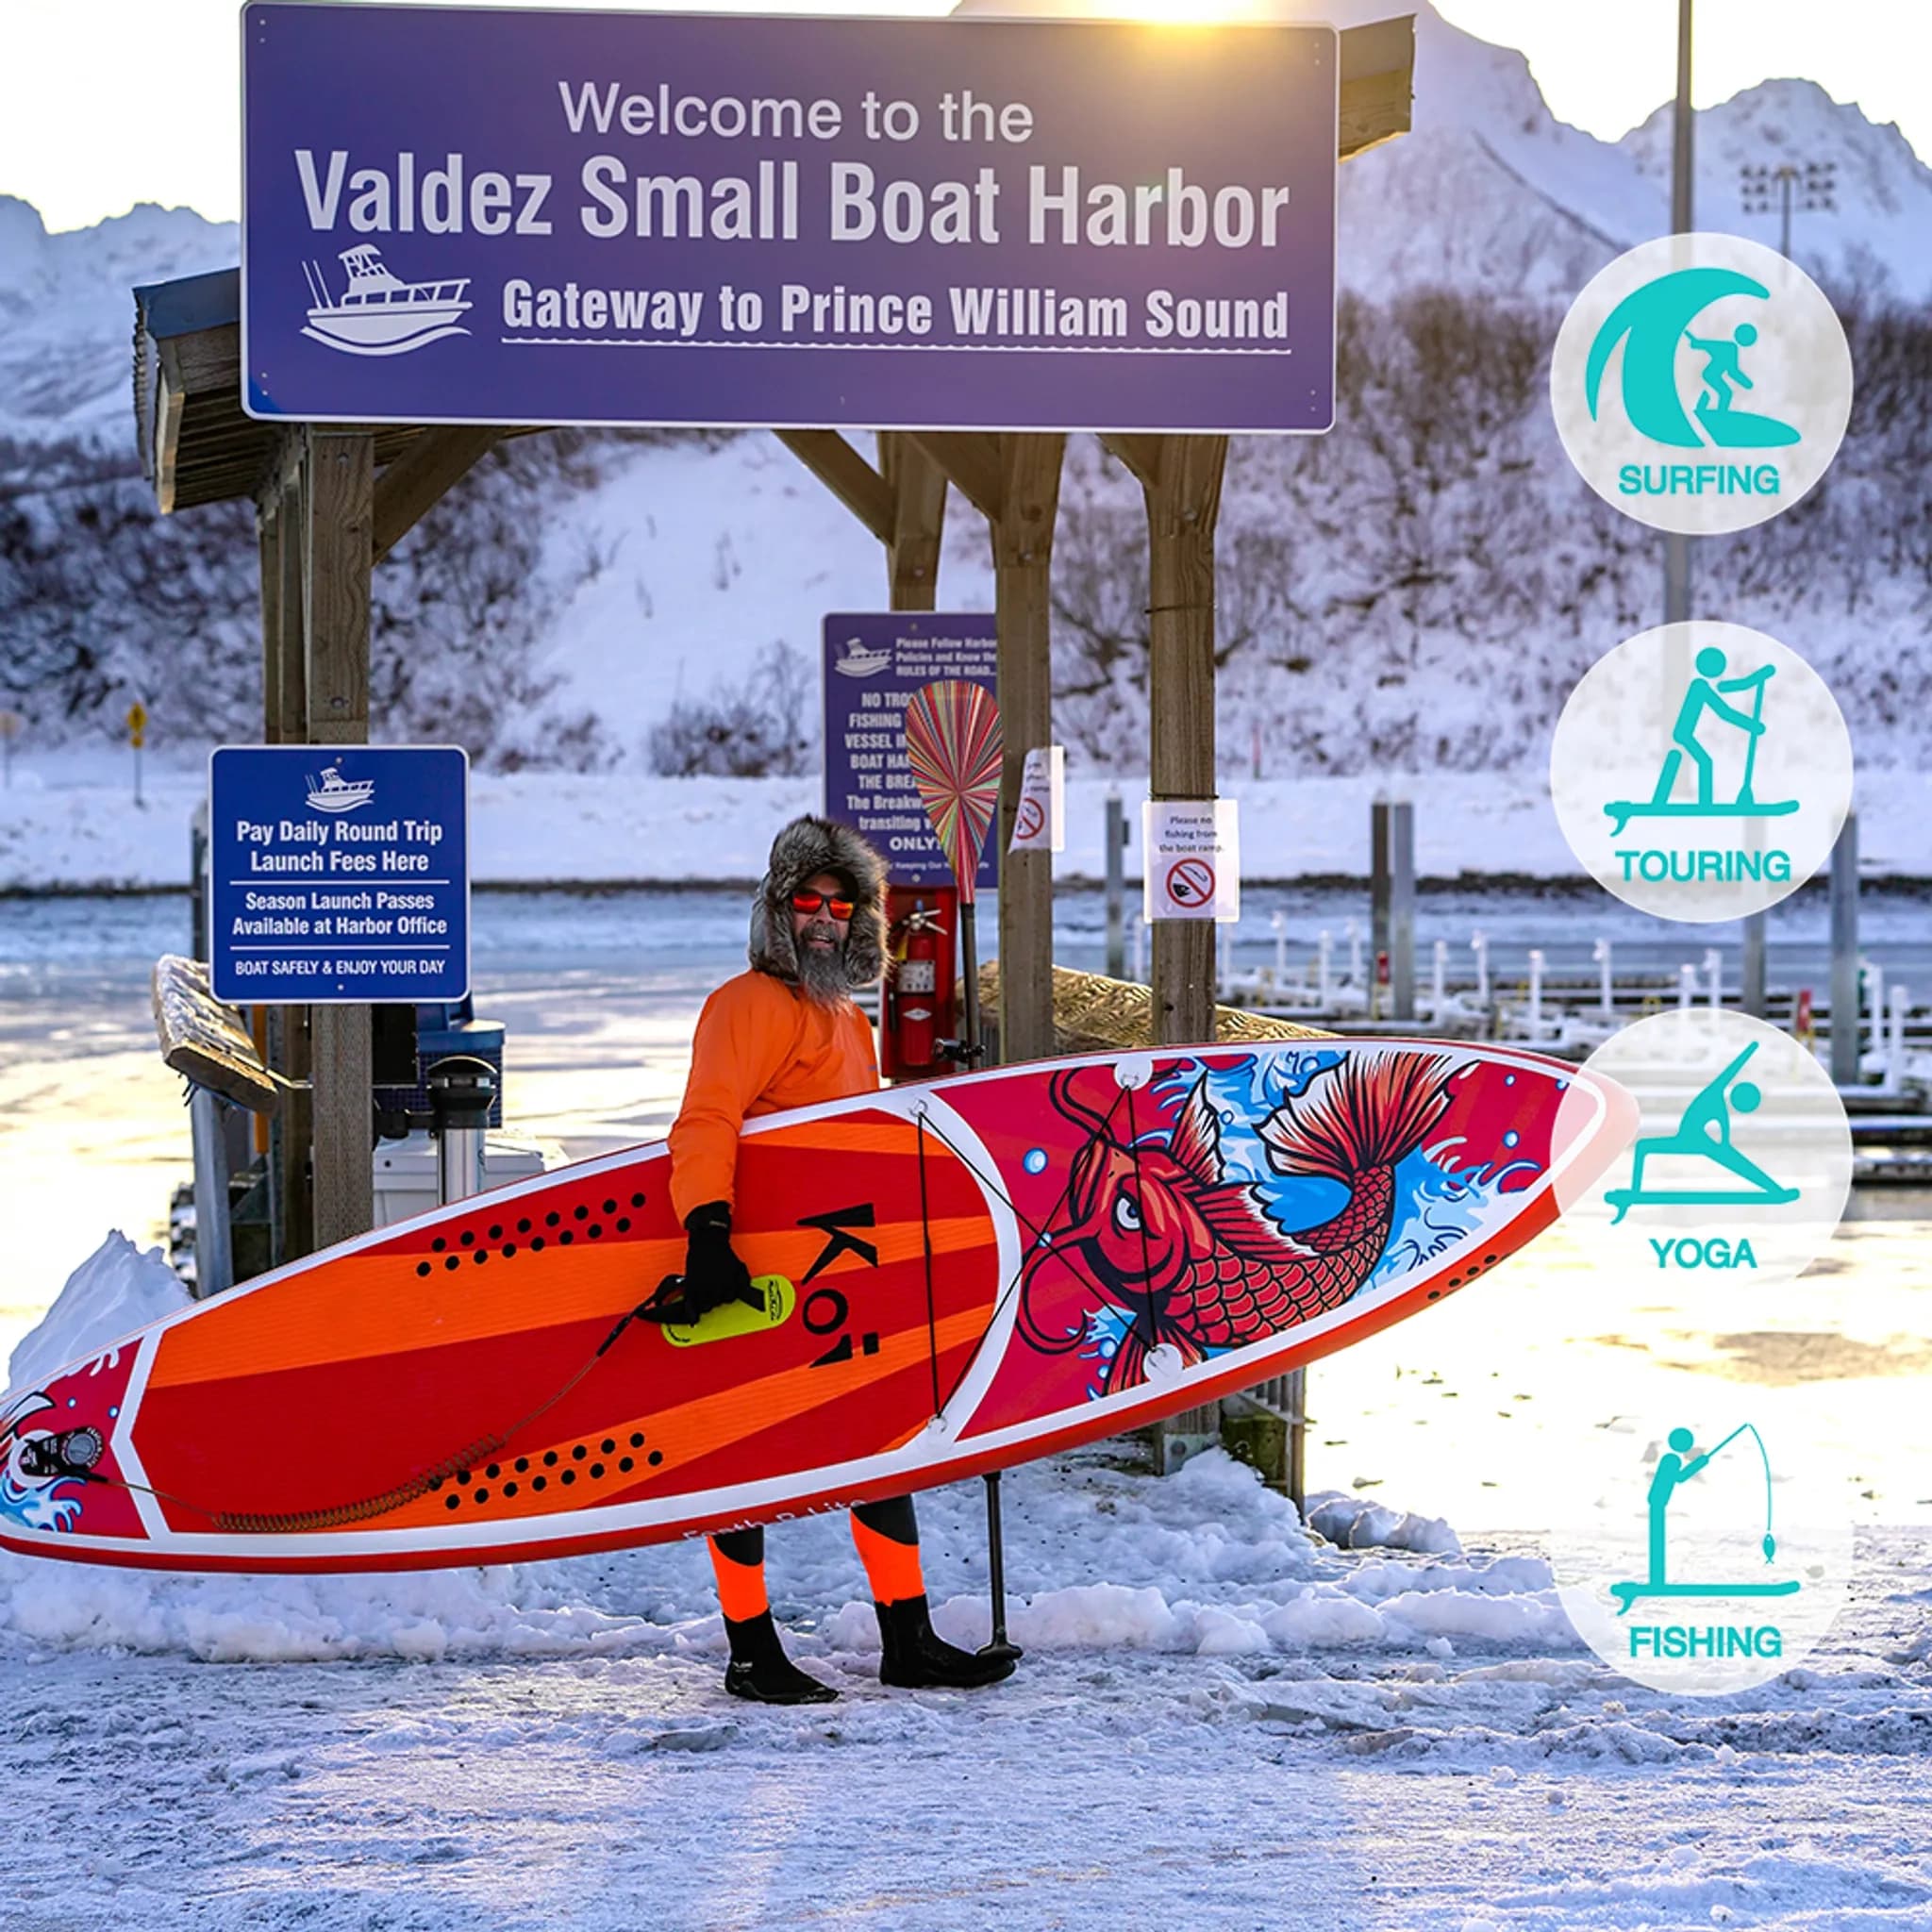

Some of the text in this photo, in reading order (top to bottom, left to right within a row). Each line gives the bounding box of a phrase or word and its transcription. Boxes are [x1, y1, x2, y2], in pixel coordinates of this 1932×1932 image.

[558, 82, 1033, 142] Welcome to the
[295, 150, 1289, 247] Valdez Small Boat Harbor
[503, 278, 1287, 338] Gateway to Prince William Sound
[896, 639, 928, 648] Please
[896, 653, 932, 662] Policies
[936, 653, 953, 661] and
[896, 666, 925, 676] RULES
[929, 666, 941, 676] OF
[943, 666, 960, 676] THE
[861, 692, 913, 707] NO TRO
[850, 713, 902, 728] FISHING
[845, 734, 892, 748] VESSEL
[851, 755, 883, 768] BOAT
[858, 774, 882, 789] THE
[847, 794, 923, 809] The Breakw
[858, 817, 921, 831] transiting
[238, 821, 441, 845] Pay Daily Round Trip
[1165, 830, 1194, 839] fishing
[252, 851, 428, 871] Launch Fees Here
[246, 892, 434, 909] Season Launch Passes
[233, 916, 446, 935] Available at Harbor Office
[236, 960, 445, 975] BOAT SAFELY & ENJOY YOUR DAY
